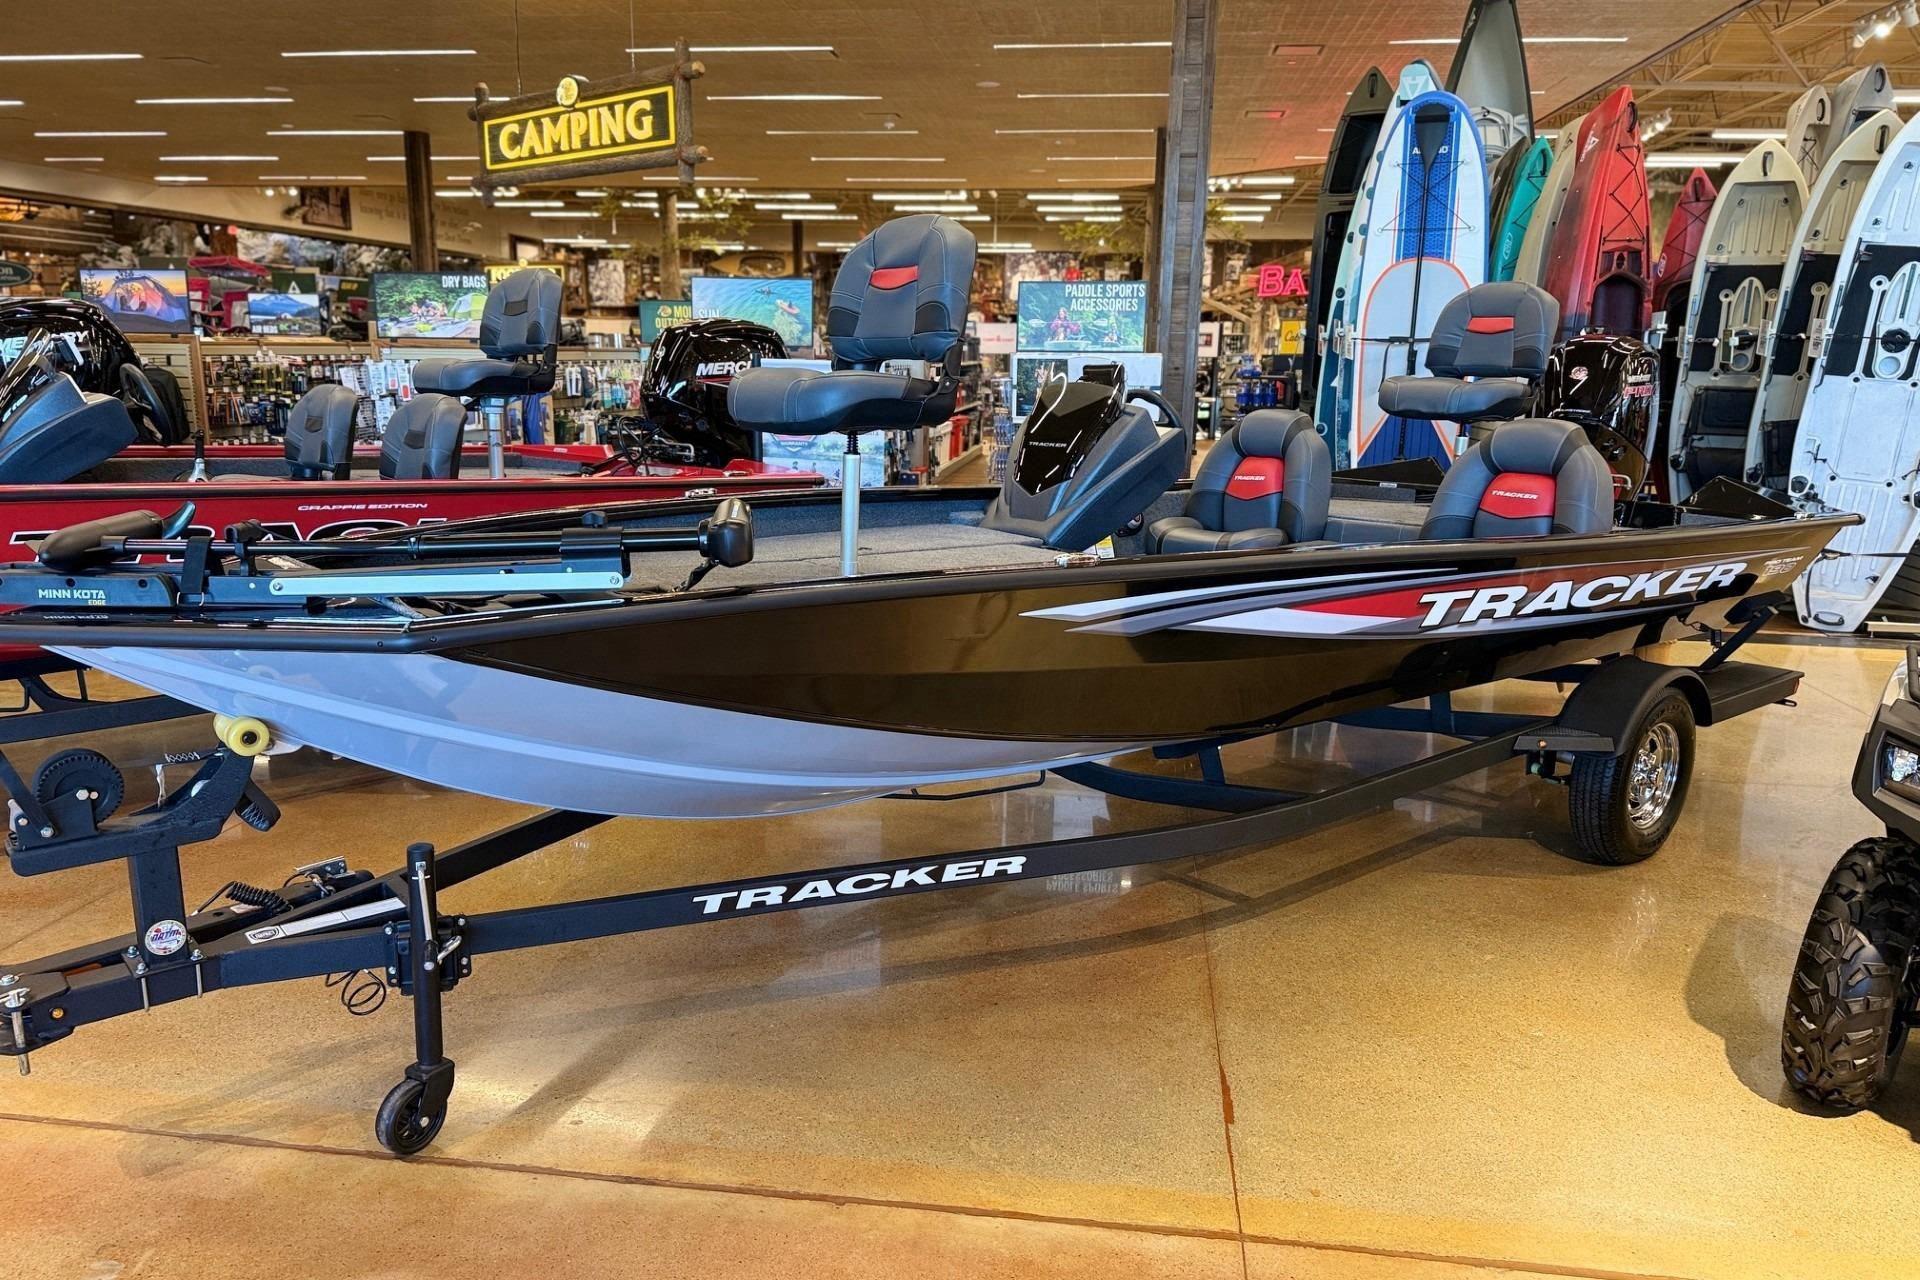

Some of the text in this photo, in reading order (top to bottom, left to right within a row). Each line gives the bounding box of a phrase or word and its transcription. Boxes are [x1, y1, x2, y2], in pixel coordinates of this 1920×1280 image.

[499, 99, 653, 160] CAMPING
[441, 275, 460, 289] DRY
[462, 275, 487, 288] BAGS
[1065, 284, 1146, 298] PADDLE SPORTS
[1070, 298, 1138, 312] ACCESSORIES
[1491, 490, 1539, 500] TRACKER
[38, 588, 106, 599] MINN KOTA
[1418, 563, 1748, 628] TRACKER
[692, 855, 1027, 914] TRACKER
